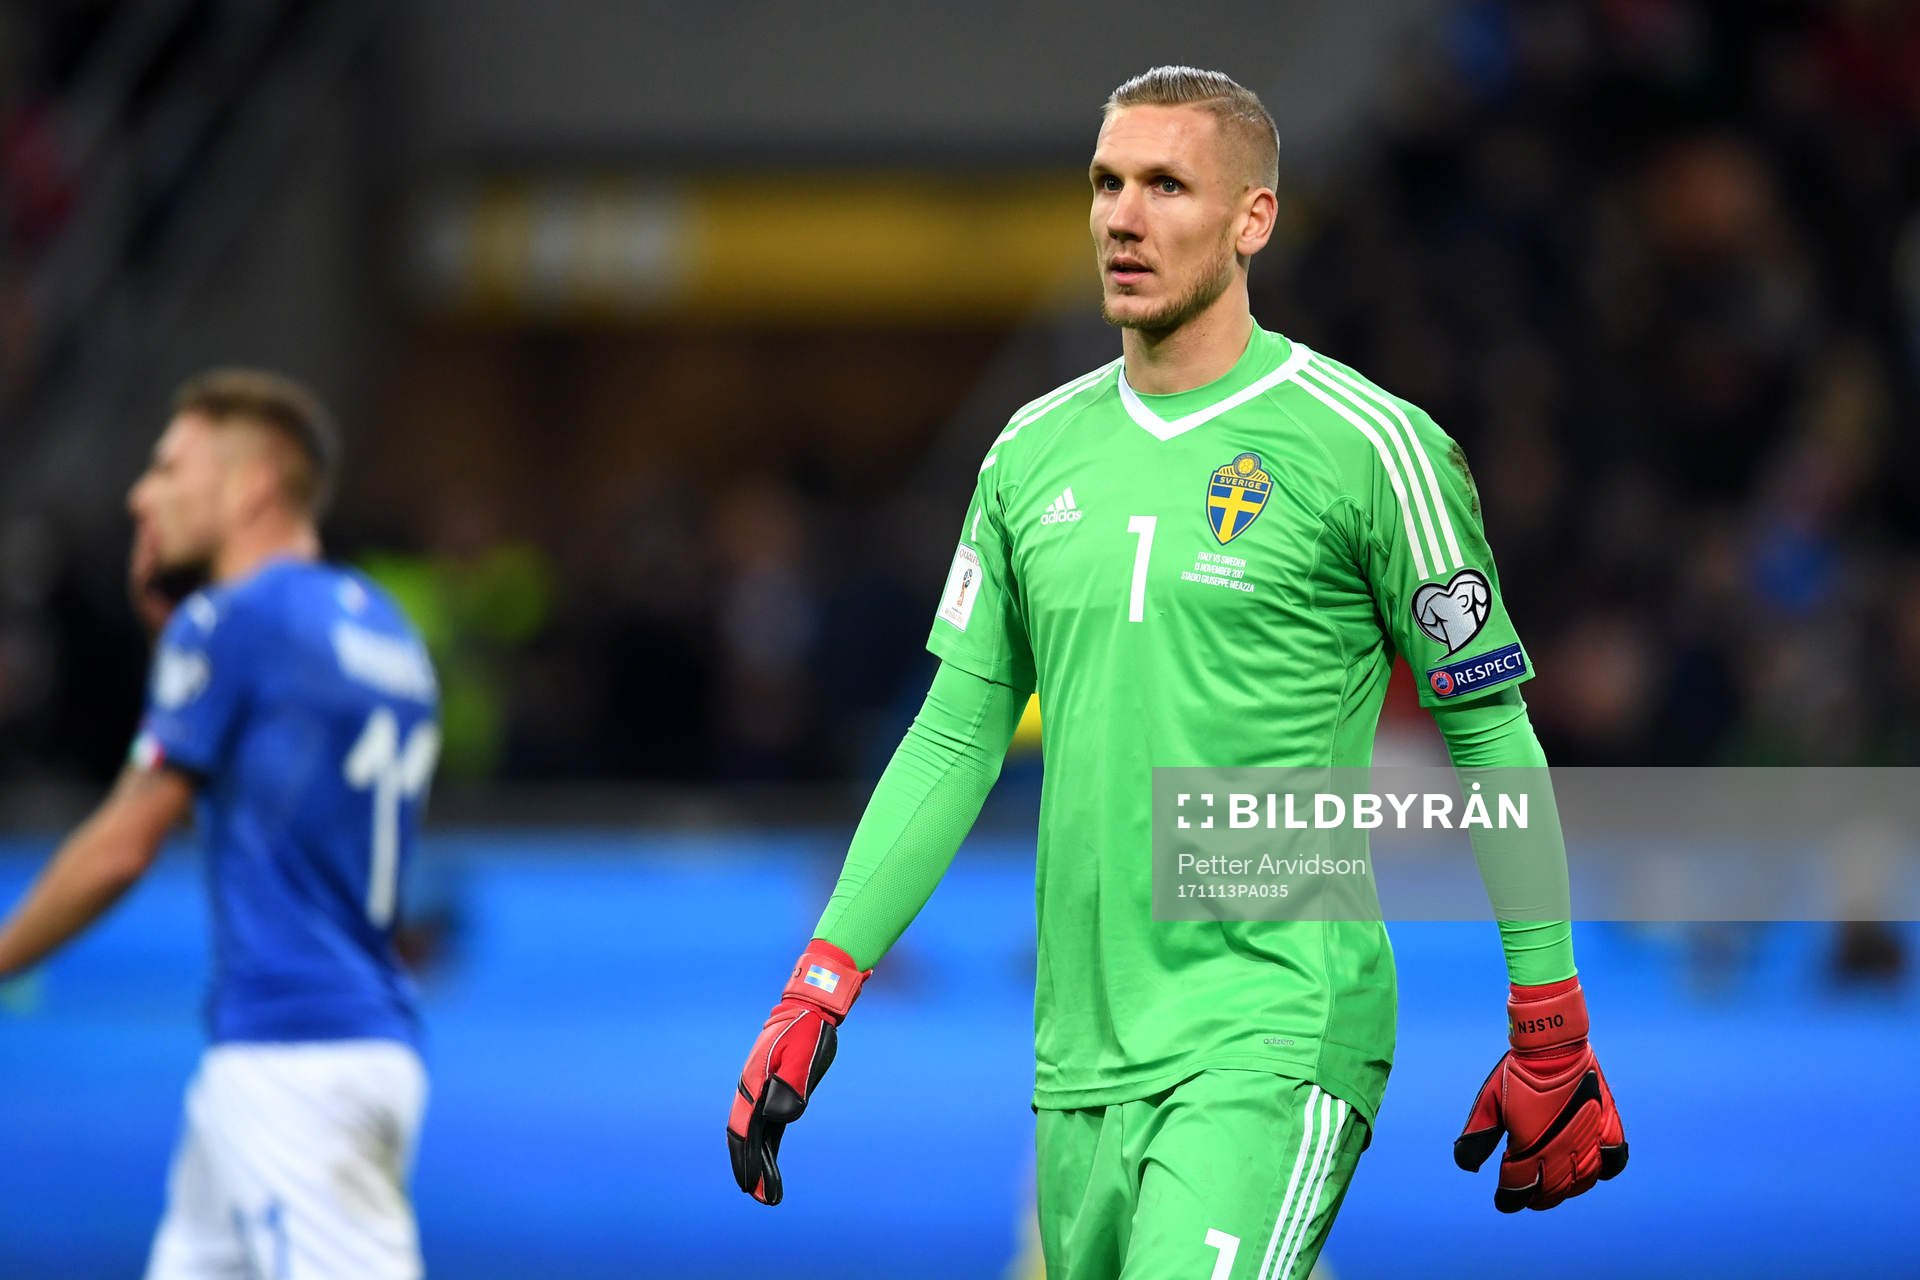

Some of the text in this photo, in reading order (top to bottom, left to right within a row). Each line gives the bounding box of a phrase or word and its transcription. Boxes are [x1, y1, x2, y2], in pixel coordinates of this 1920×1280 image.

[1219, 476, 1262, 489] SVERIGE
[1040, 510, 1082, 526] adidas
[1198, 552, 1212, 561] ITALY
[1221, 555, 1246, 567] SWEDEN
[1127, 516, 1157, 622] 1
[1200, 563, 1231, 576] NOVEMBER
[1181, 571, 1254, 592] STADIO GIUSEPPE MEAZZA
[1454, 652, 1522, 686] RESPECT
[1517, 1014, 1564, 1034] OLSEN
